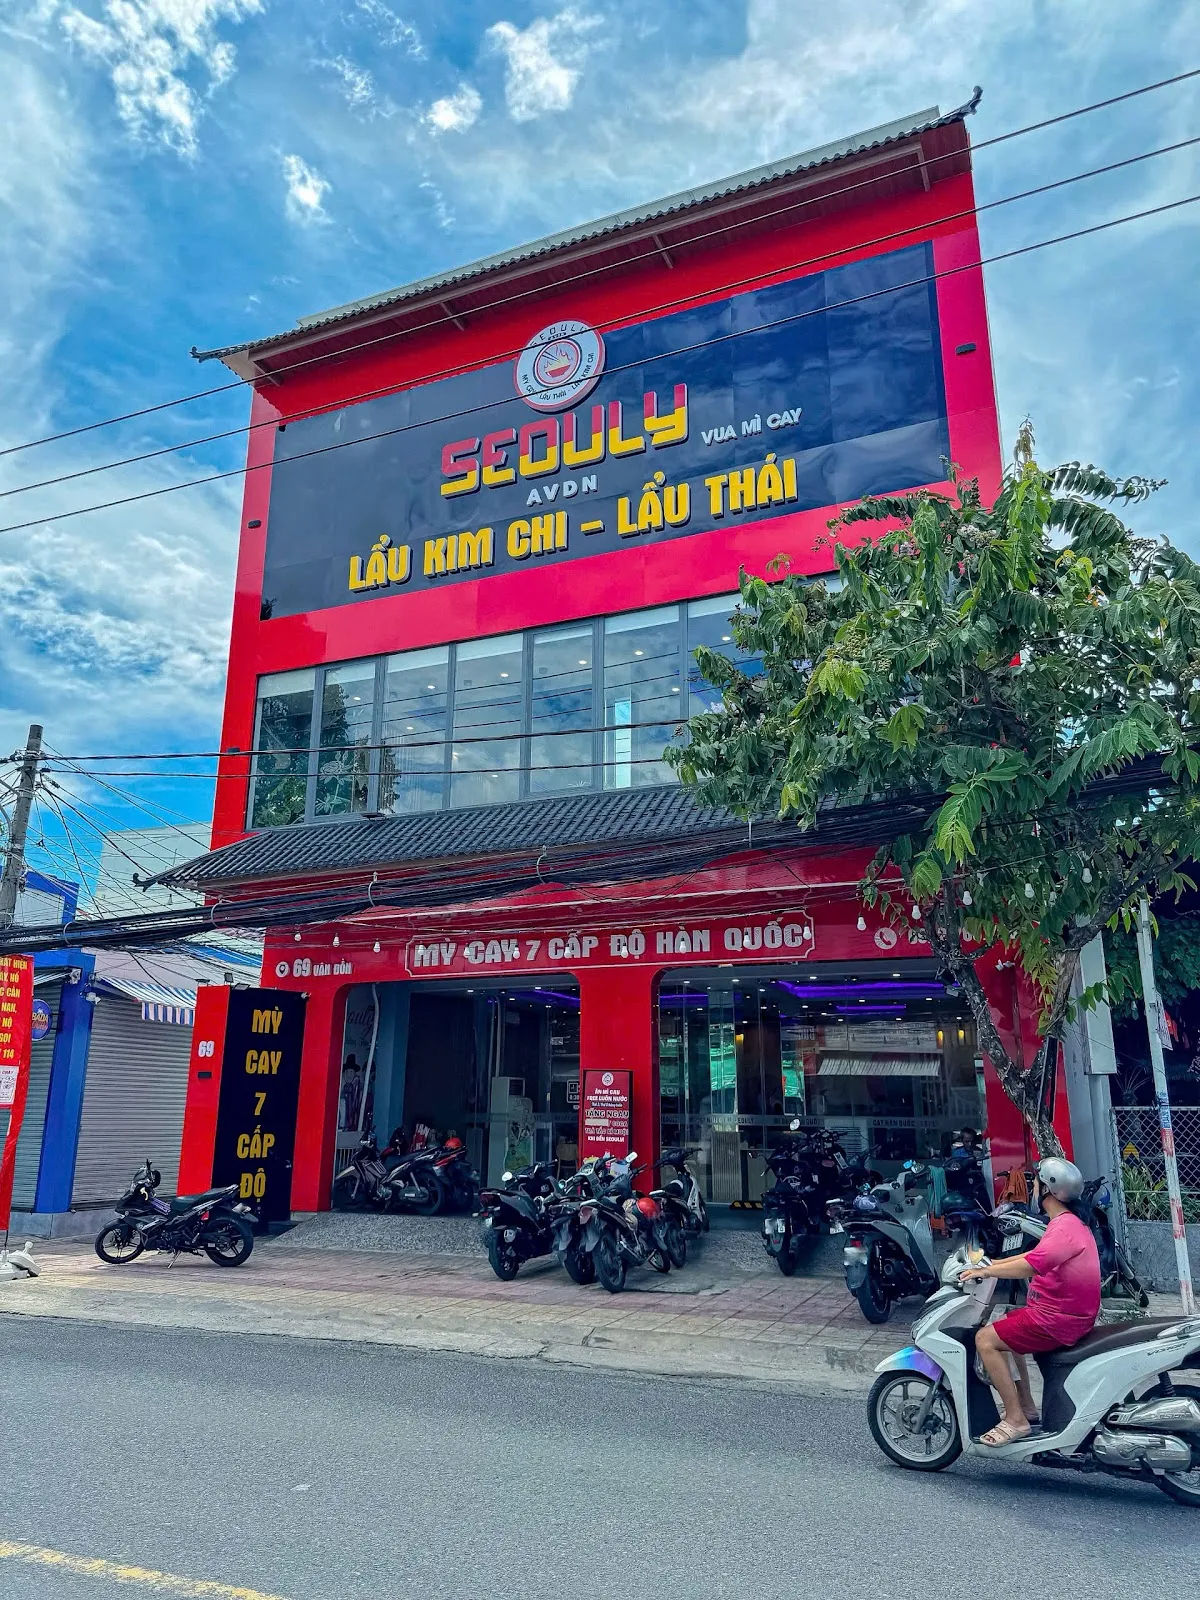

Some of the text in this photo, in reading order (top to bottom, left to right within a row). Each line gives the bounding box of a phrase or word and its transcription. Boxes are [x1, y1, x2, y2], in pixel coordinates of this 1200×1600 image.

[440, 382, 690, 498] SEOULY
[700, 407, 803, 447] VUA MÌ CAY
[526, 474, 599, 507] AVDN
[348, 534, 413, 592] LẨU
[423, 527, 494, 578] KIM
[506, 510, 569, 560] CHI
[617, 471, 691, 537] LẨU
[704, 453, 799, 518] THÁI
[413, 937, 457, 968] MỲ
[467, 939, 519, 964] CAY
[525, 939, 541, 962] 7
[608, 928, 646, 960] ĐỘ
[655, 923, 711, 954] HÀN
[723, 916, 804, 952] QUỐC
[292, 957, 312, 978] 69
[251, 1005, 284, 1035] MỲ
[3, 1048, 15, 1059] 114
[197, 1040, 215, 1058] 69
[245, 1049, 283, 1075] CAY
[253, 1091, 267, 1116] 7
[236, 1124, 276, 1159] CẤP
[239, 1167, 267, 1203] ĐỘ
